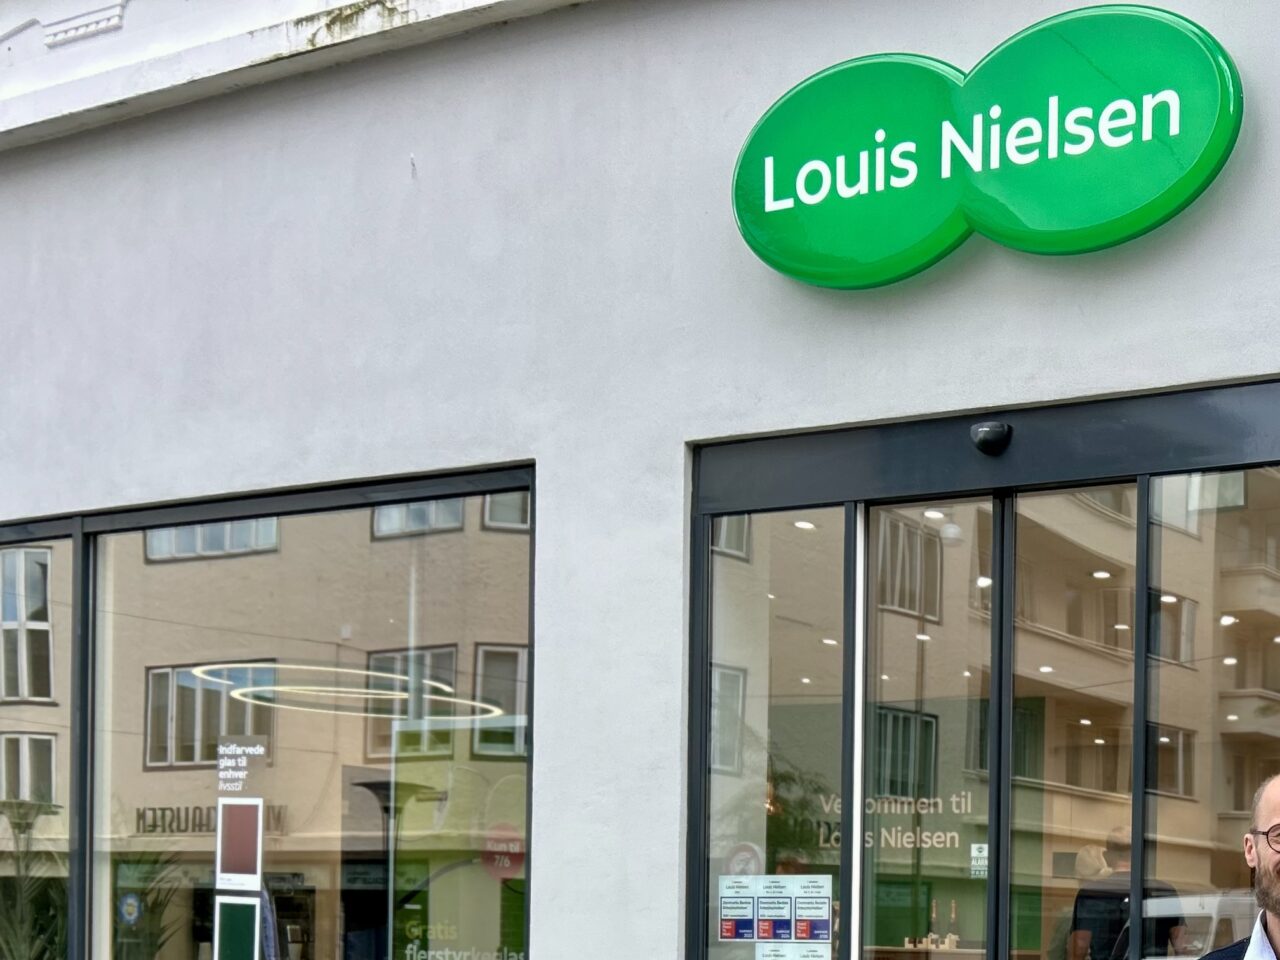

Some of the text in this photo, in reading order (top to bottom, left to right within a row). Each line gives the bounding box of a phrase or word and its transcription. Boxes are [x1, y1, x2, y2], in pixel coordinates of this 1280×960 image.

[764, 89, 1181, 212] Louis Nielsen
[218, 744, 265, 755] Indfarvede
[219, 757, 247, 768] glas til
[218, 769, 248, 779] enhver
[819, 791, 971, 814] Veommen til
[819, 826, 959, 848] Los Nielsen
